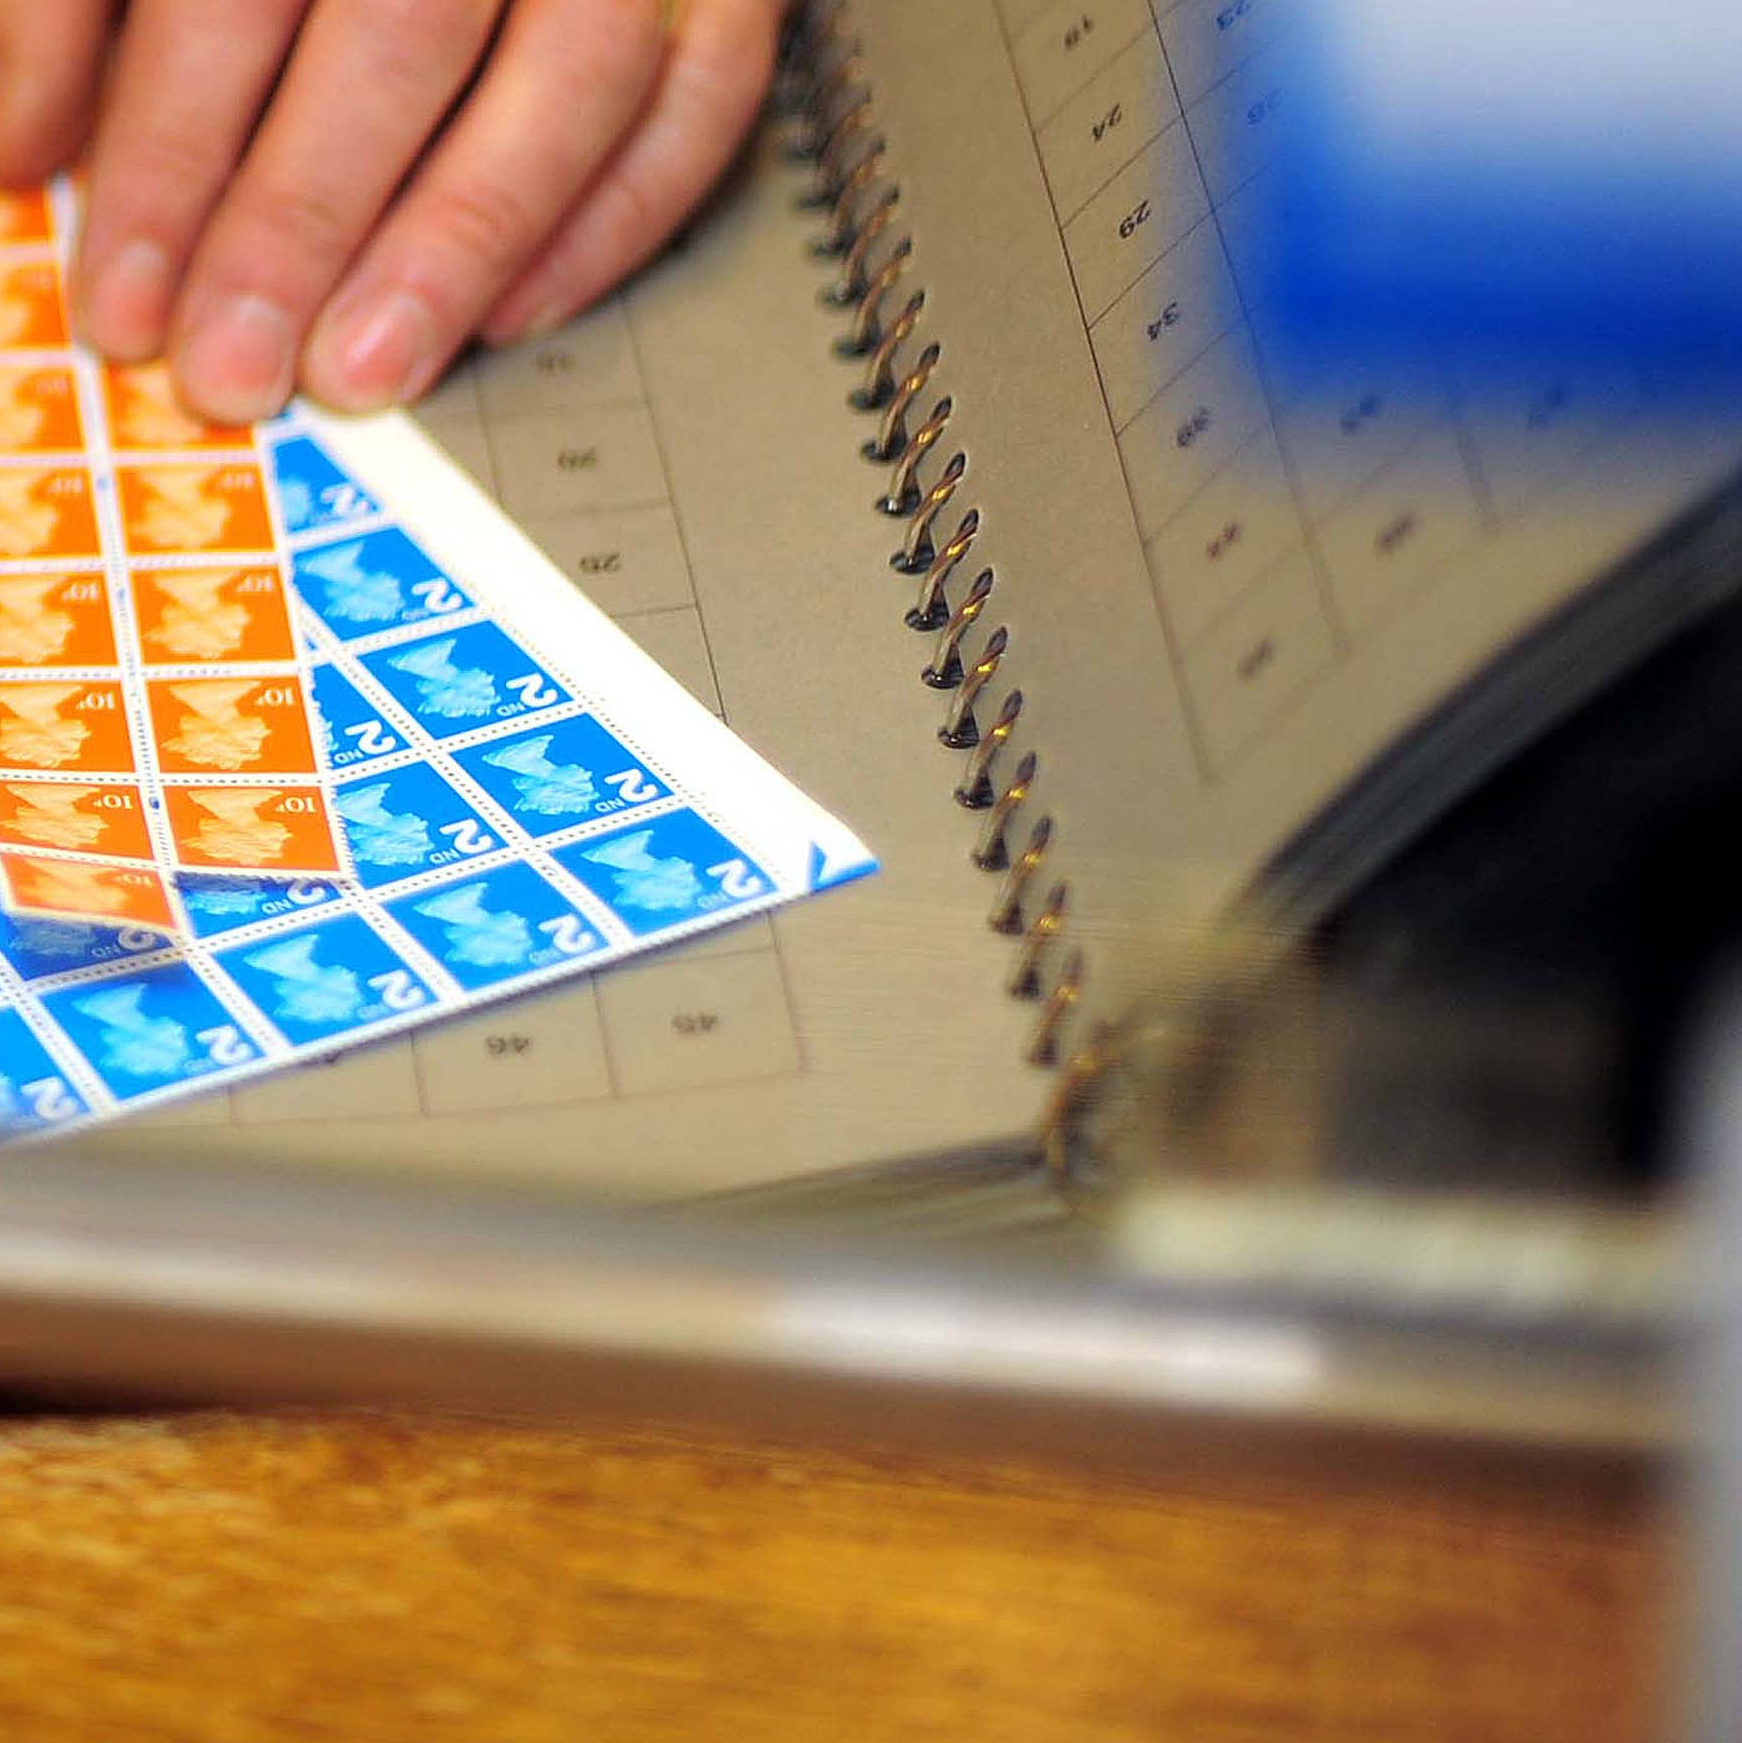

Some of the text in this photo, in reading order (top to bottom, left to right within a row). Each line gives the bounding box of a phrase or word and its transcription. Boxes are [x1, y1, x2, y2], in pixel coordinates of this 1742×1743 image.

[1091, 104, 1123, 143] 24
[1119, 198, 1152, 240] 29
[1147, 301, 1180, 341] 34
[496, 673, 559, 717] 2ND
[334, 719, 395, 764] 2ND
[594, 768, 658, 813] 2ND
[429, 818, 492, 865] 2ND
